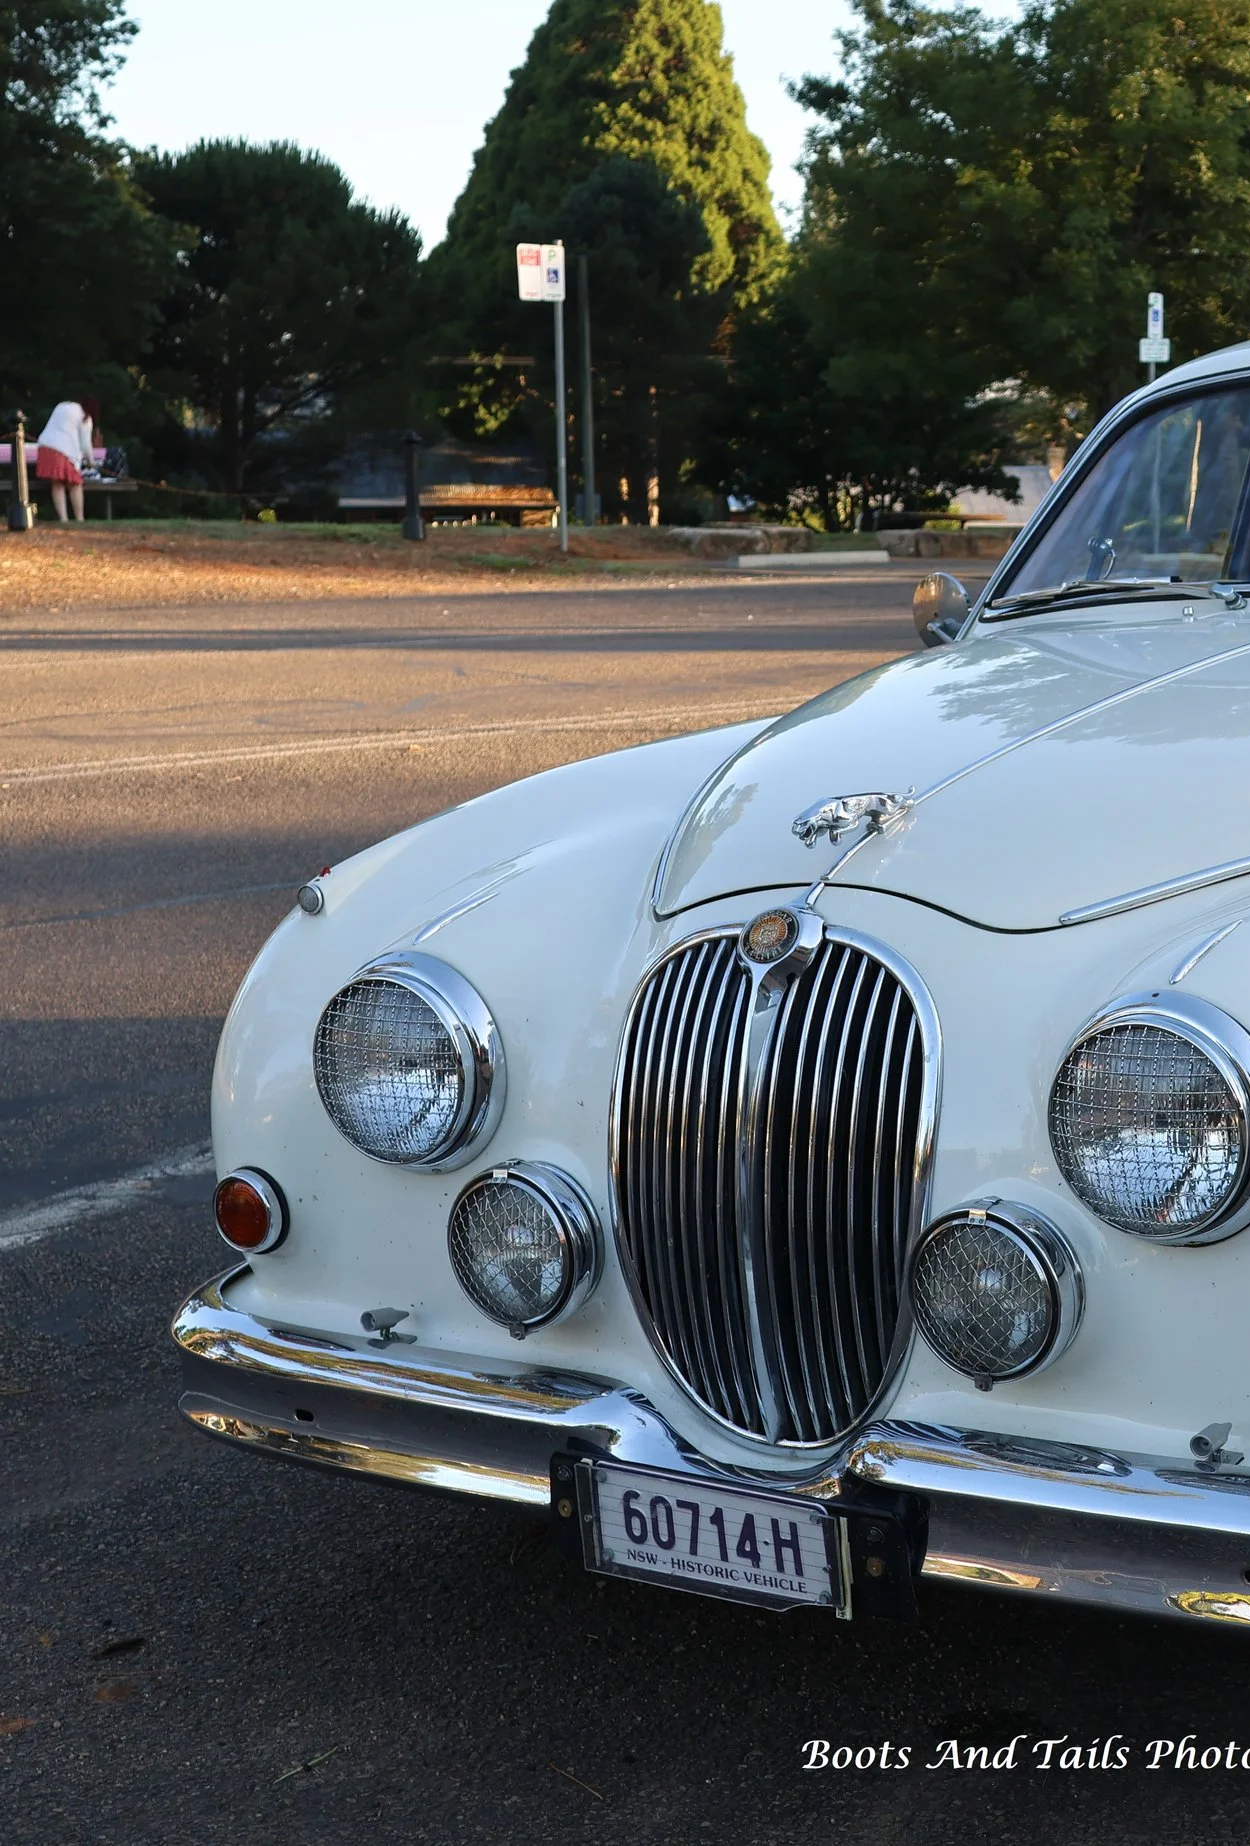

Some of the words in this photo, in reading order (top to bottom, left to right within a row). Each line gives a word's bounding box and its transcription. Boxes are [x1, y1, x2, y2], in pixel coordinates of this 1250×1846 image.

[627, 1548, 658, 1565] NSW
[670, 1557, 739, 1581] HISTORIC
[743, 1571, 808, 1594] VEHICLE
